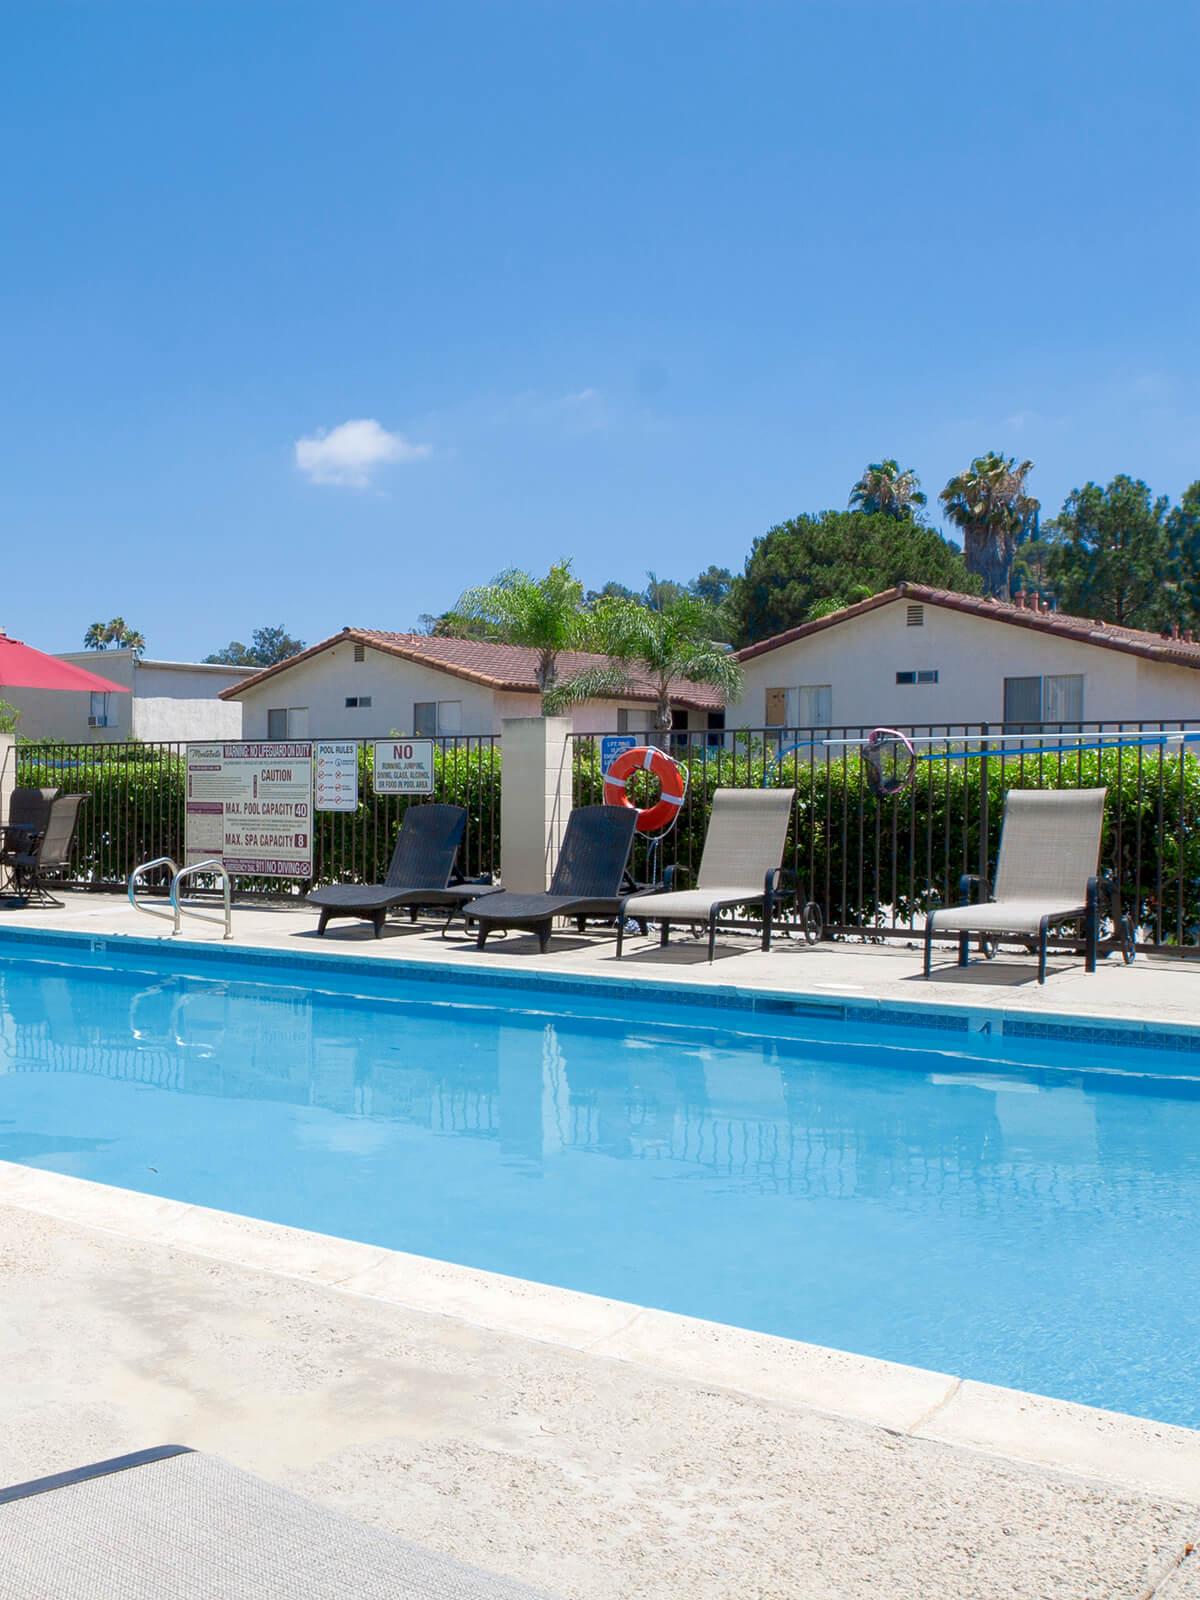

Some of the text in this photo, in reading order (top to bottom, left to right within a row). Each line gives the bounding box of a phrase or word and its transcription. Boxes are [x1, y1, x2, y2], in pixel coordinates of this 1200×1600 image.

[250, 745, 258, 757] NO
[258, 745, 286, 757] LIFEGUARD
[287, 745, 295, 757] ON
[295, 744, 309, 757] DUTY
[319, 746, 353, 754] POOL RULES
[393, 745, 413, 760] NO
[261, 768, 292, 782] CAUTION
[386, 780, 397, 789] FOOD
[225, 803, 242, 815] MAX.
[243, 803, 261, 815] POOL
[262, 804, 293, 817] CAPACITY
[296, 805, 307, 817] 40
[225, 833, 305, 848] MAX. SPA CAPACITY 8
[256, 861, 265, 873] 911
[266, 862, 276, 874] NO
[277, 862, 300, 876] DIVING
